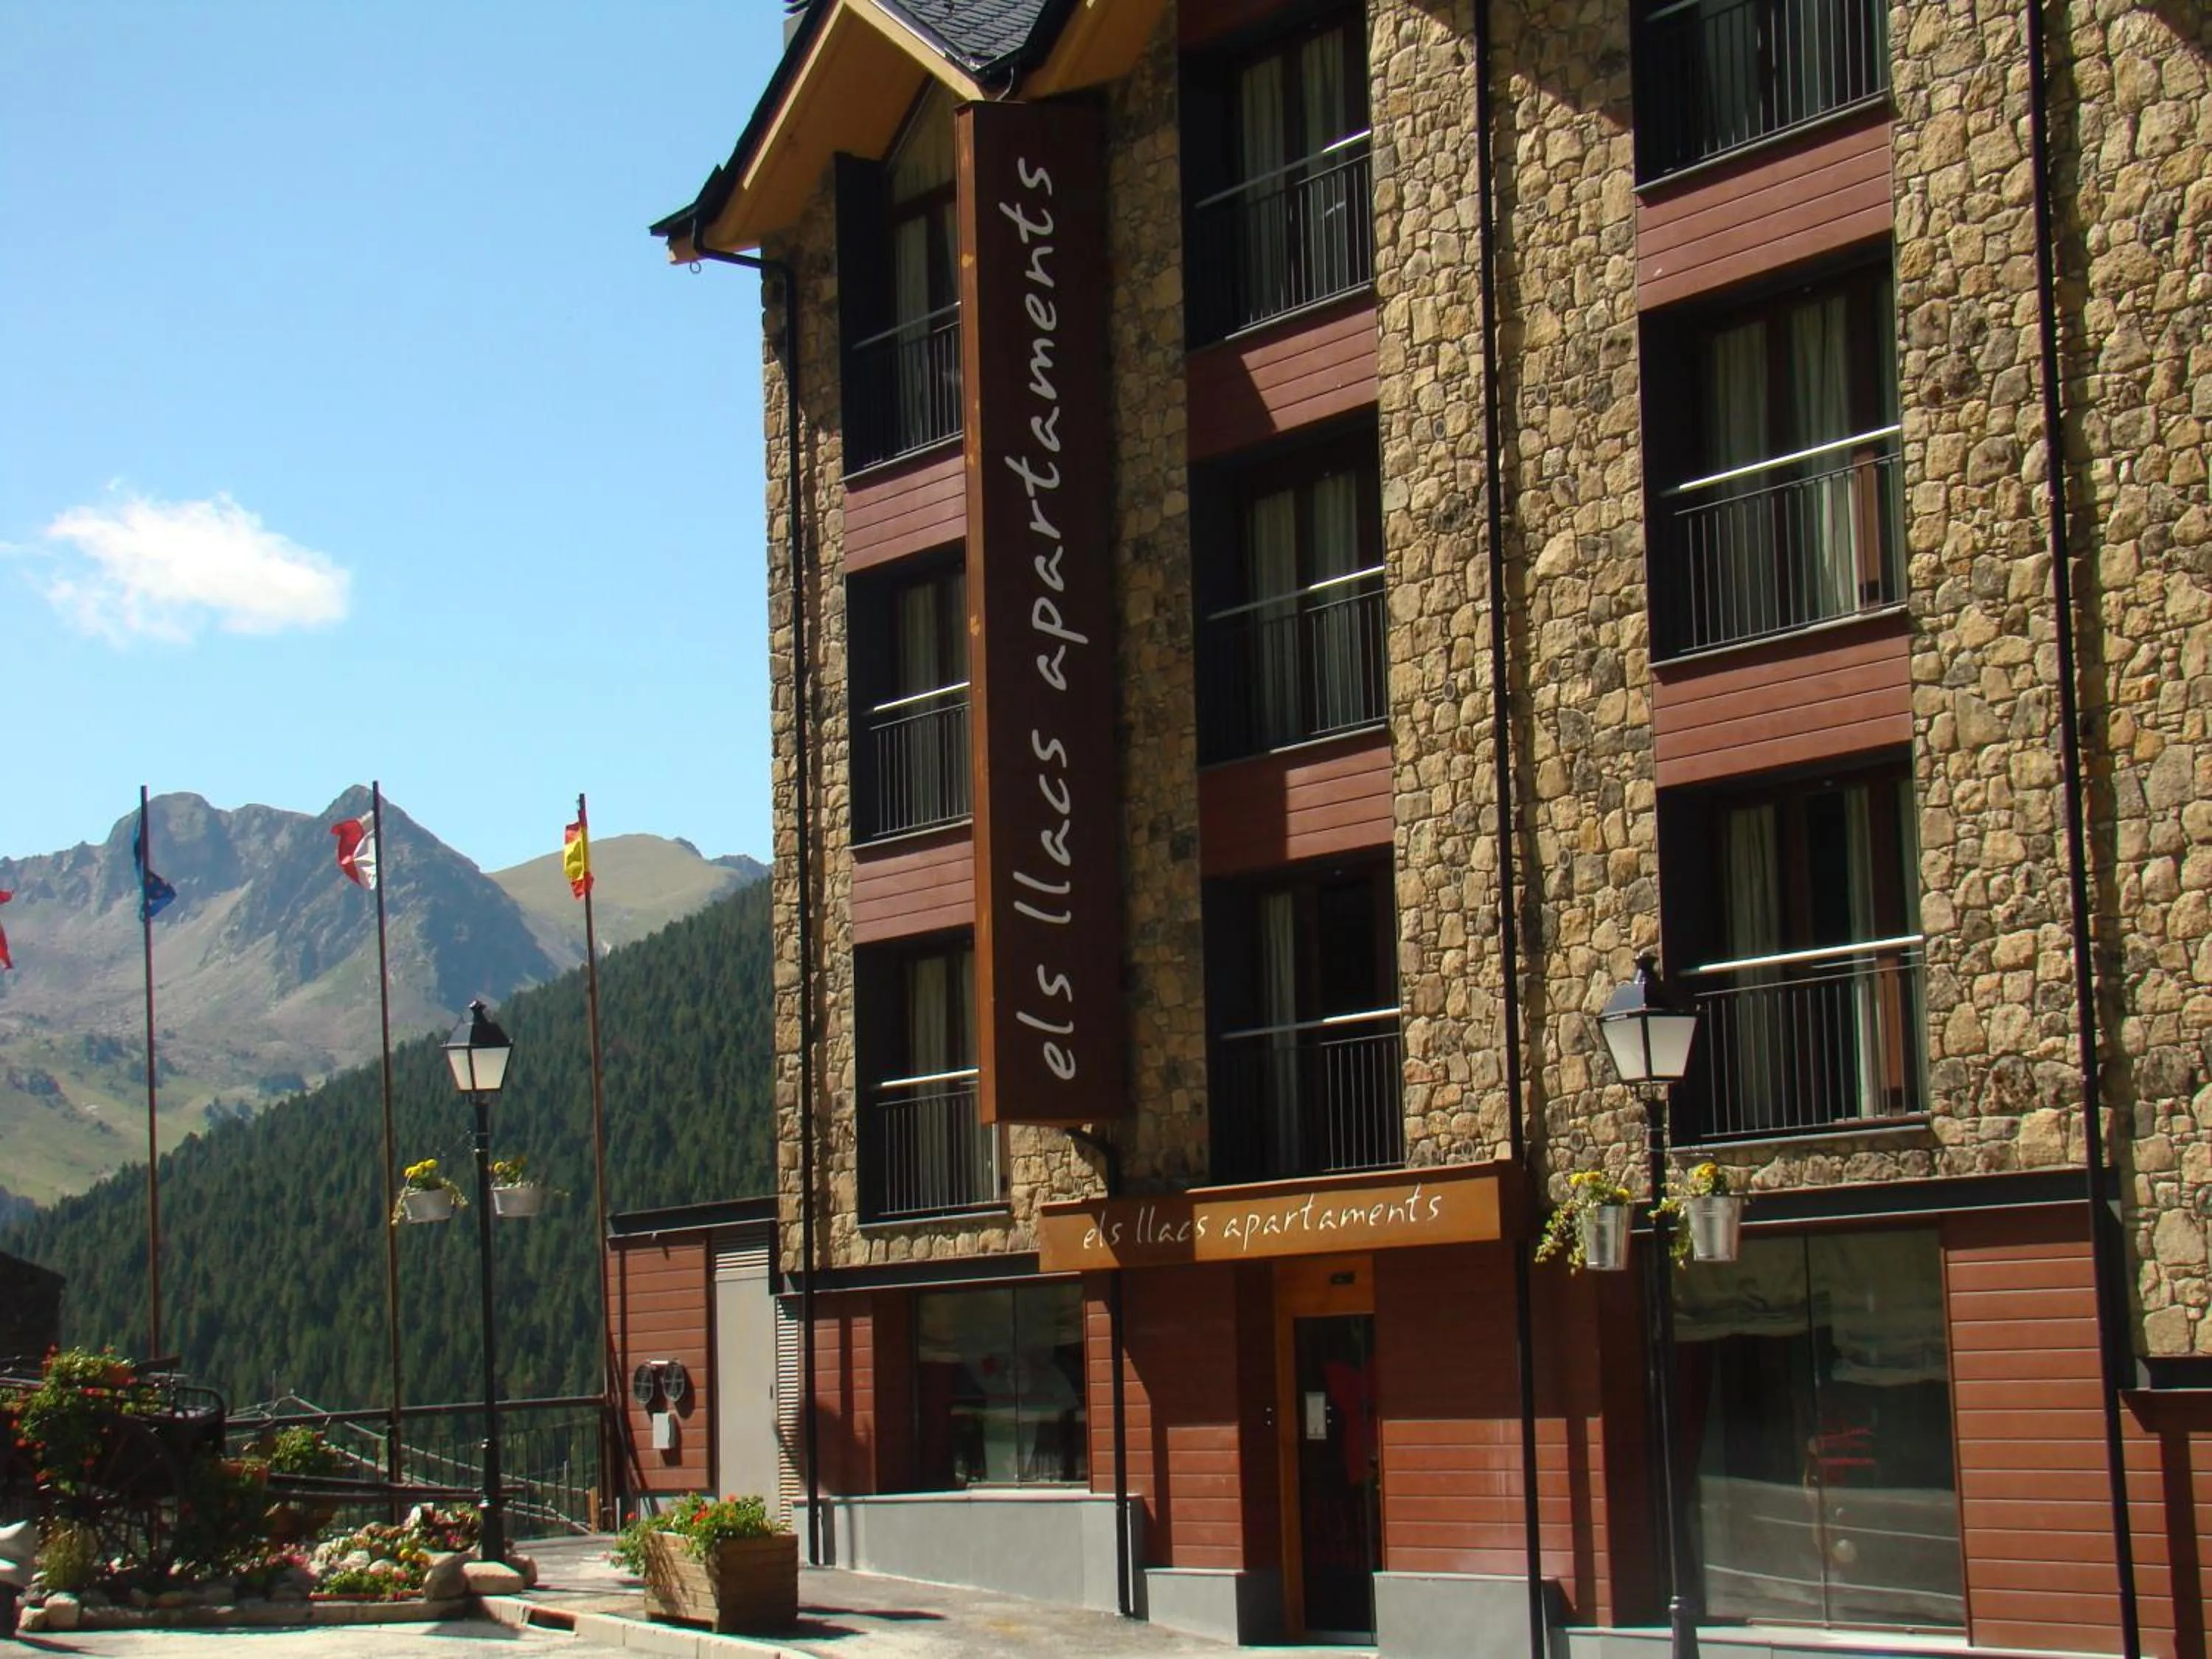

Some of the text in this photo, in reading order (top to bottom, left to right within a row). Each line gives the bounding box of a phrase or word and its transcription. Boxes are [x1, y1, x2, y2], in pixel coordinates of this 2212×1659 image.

[998, 156, 1088, 1080] els llacs apartaments
[1082, 1183, 1441, 1251] els llacs apartaments
